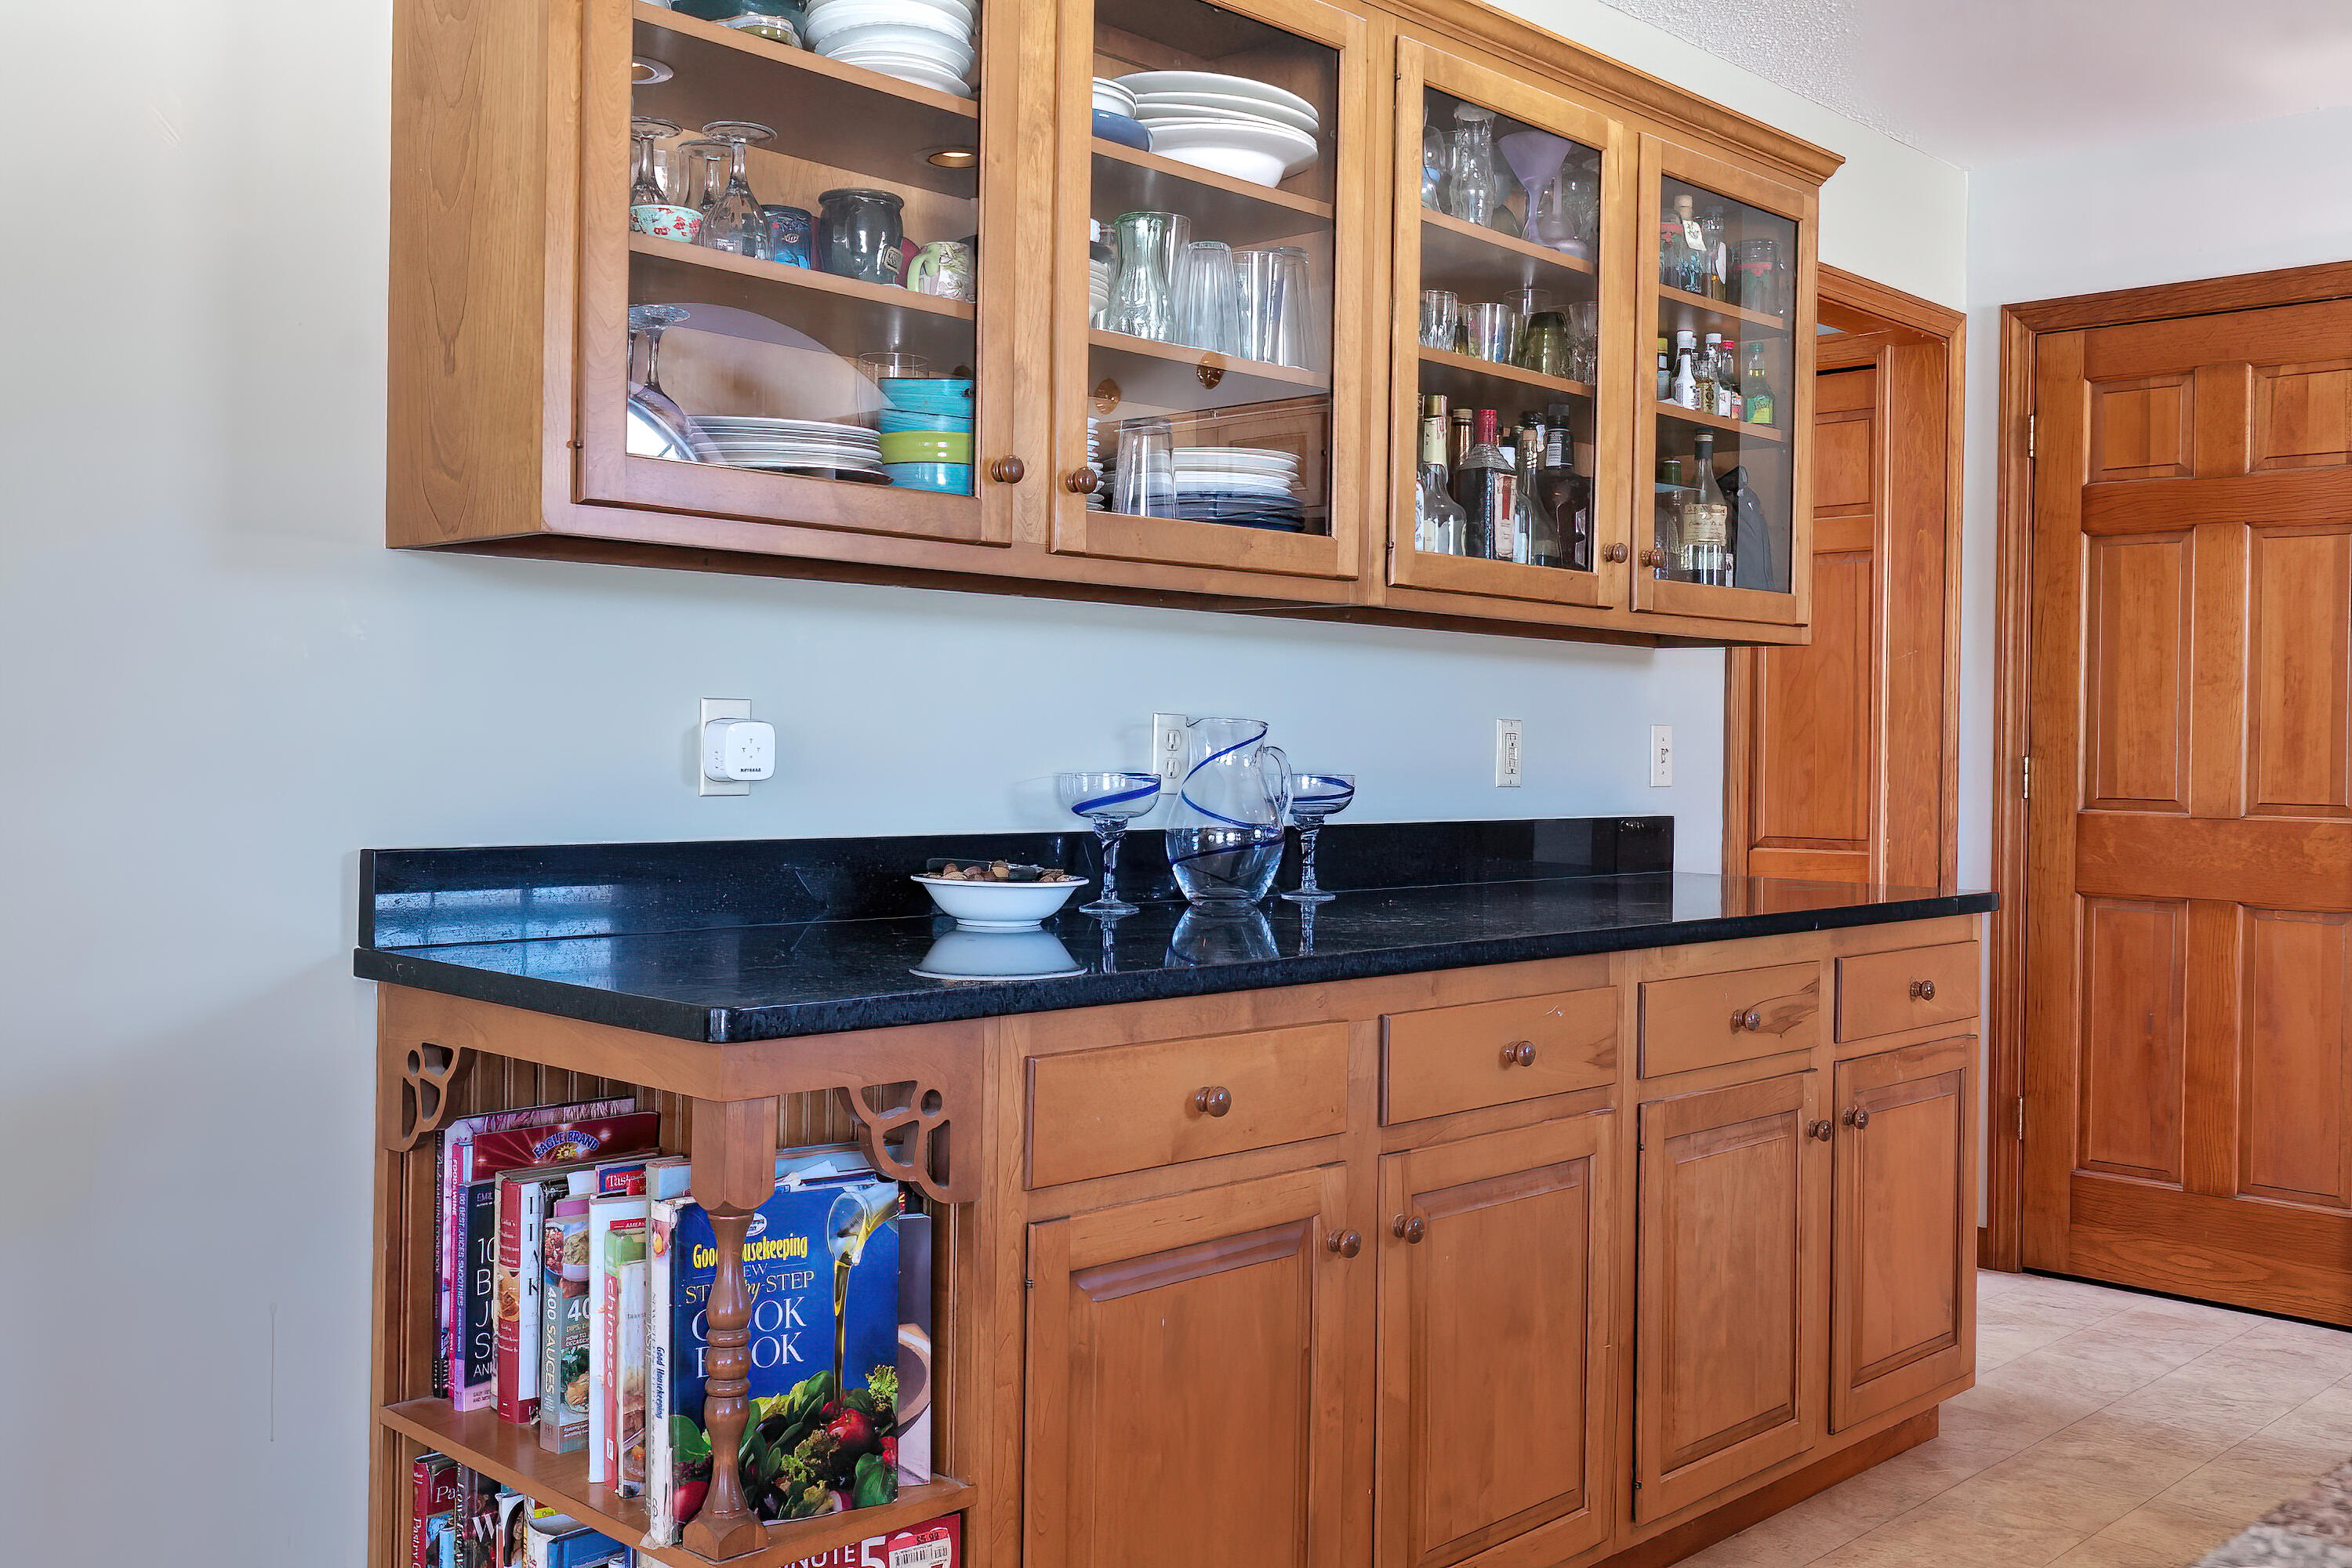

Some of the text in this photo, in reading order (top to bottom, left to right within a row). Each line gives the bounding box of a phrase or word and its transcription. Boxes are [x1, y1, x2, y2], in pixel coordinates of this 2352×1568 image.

[532, 1130, 599, 1159] EAGLE BRAND
[477, 1236, 495, 1264] 10
[692, 1232, 808, 1269] Goo usekeeping
[743, 1263, 768, 1278] EW
[766, 1270, 815, 1293] STEP
[546, 1287, 557, 1320] 400
[567, 1298, 590, 1321] 40
[606, 1279, 615, 1388] chinese
[545, 1323, 557, 1395] SAUCES
[655, 1346, 665, 1419] Good Housekeeping
[412, 1517, 422, 1559] Pastry
